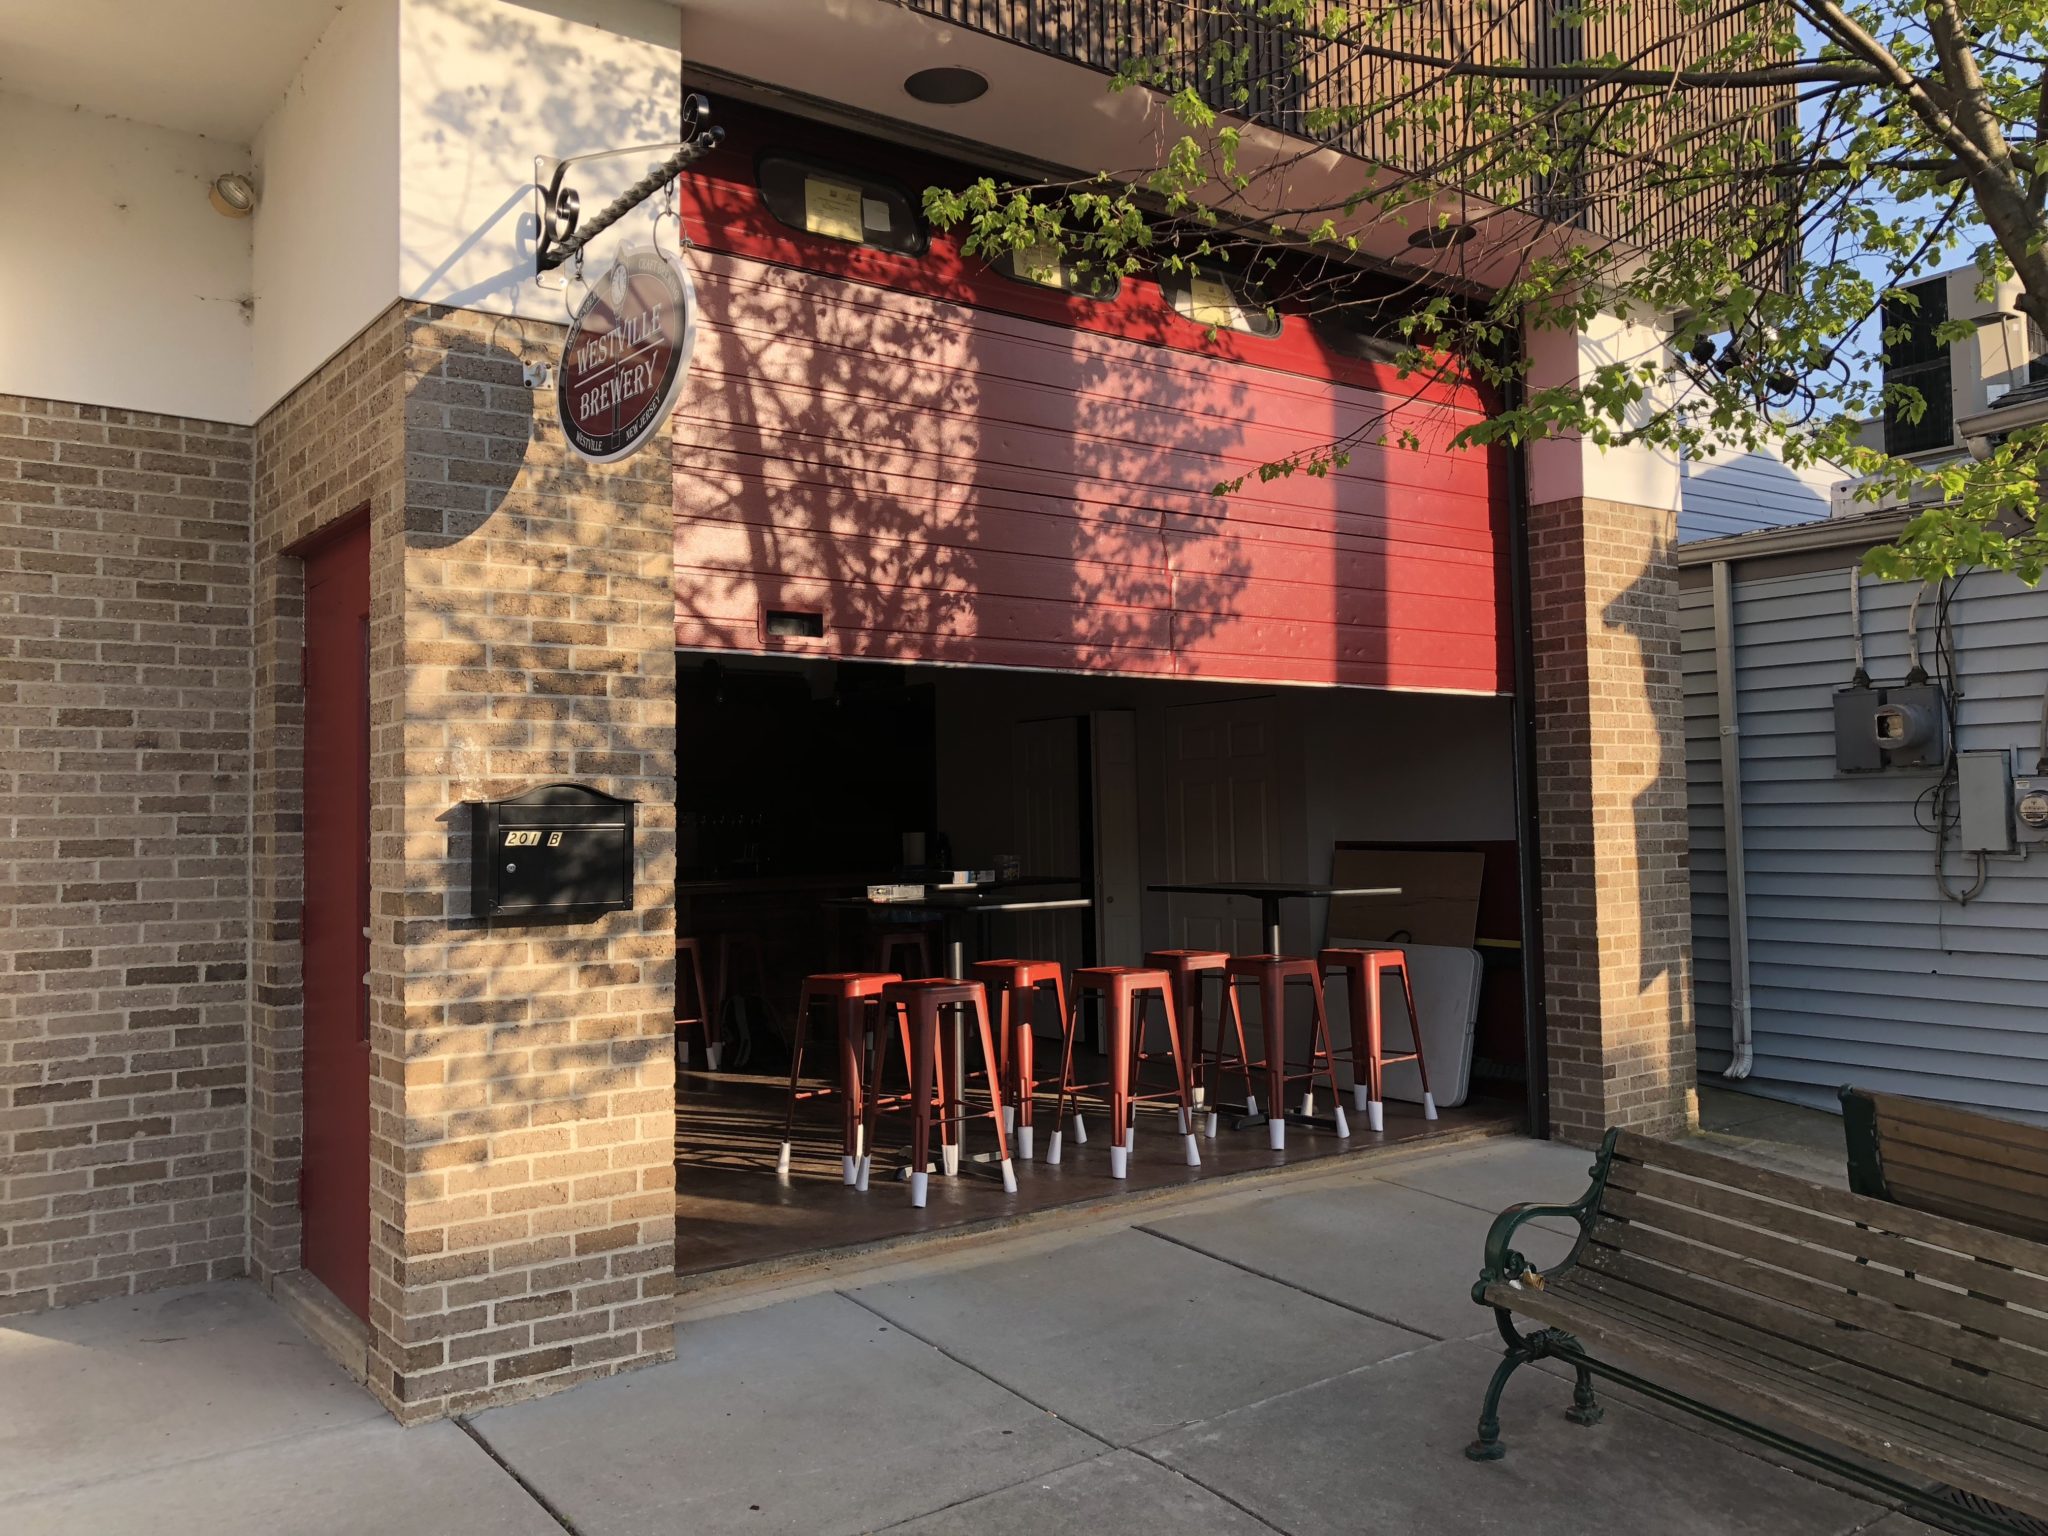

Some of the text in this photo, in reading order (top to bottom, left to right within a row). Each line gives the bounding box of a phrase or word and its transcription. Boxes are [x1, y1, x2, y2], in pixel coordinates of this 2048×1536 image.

[577, 303, 663, 376] WESTVILLE
[579, 350, 660, 422] BREWERY
[576, 430, 603, 452] WESTVILLE
[626, 389, 660, 441] NEW JERSEY
[507, 832, 561, 845] 201 B
